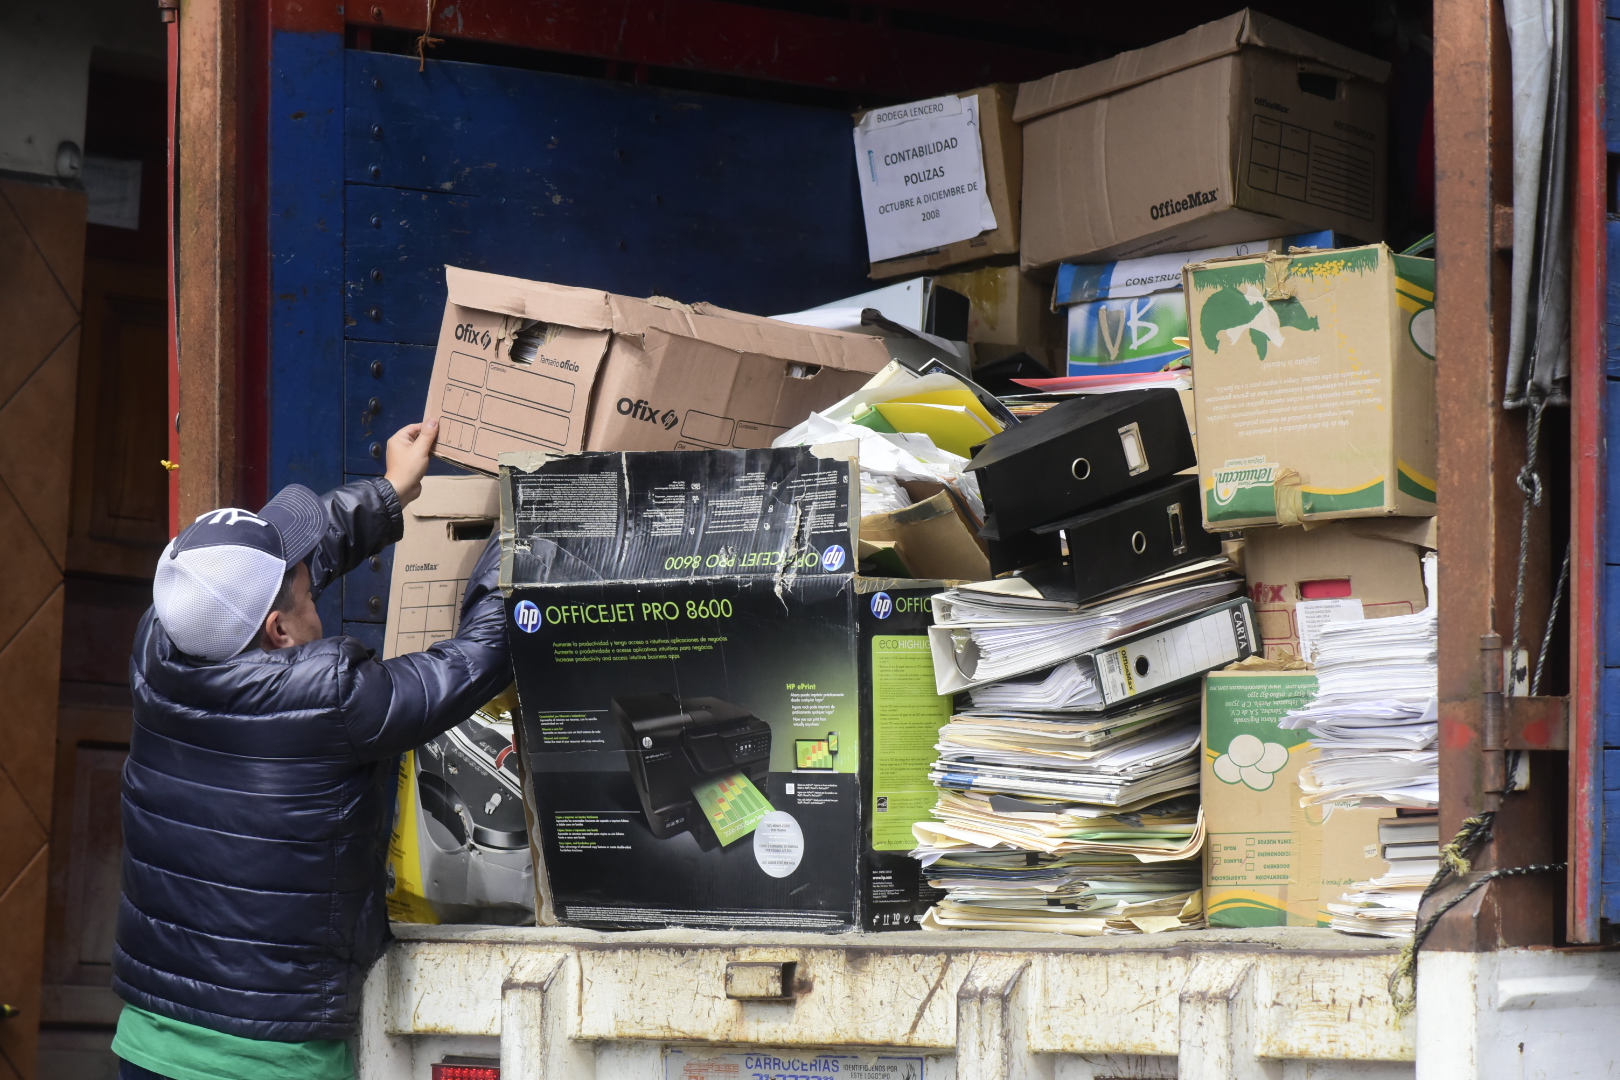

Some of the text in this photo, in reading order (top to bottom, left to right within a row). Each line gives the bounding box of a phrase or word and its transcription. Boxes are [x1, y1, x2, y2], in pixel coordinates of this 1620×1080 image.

[877, 103, 944, 123] BODEGA LENCERO
[1254, 97, 1290, 114] OfficeMax
[966, 108, 976, 126] 2
[884, 137, 958, 167] CONTABILIDAD
[904, 166, 945, 186] POLIZAS
[878, 181, 978, 215] OCTUBRE A DICIEMBRE DE
[1150, 187, 1219, 221] OfficeMax
[921, 209, 941, 222] 2008
[1125, 273, 1181, 287] CONSTRUC
[455, 323, 480, 346] Ofix
[540, 354, 580, 373] Tamaño oficio
[616, 397, 661, 424] Ofix
[1218, 467, 1274, 487] Tehuacán
[405, 563, 439, 572] OfficeMax
[665, 555, 702, 571] 8600
[824, 545, 844, 571] hp
[873, 592, 892, 619] hp
[519, 599, 733, 633] hp OFFICEJET PRO 8600
[1233, 611, 1248, 650] CARTA
[578, 639, 608, 647] productividad
[670, 635, 699, 644] aplicaciones
[574, 654, 600, 664] productivity
[1122, 650, 1135, 691] OfficeMax
[1233, 715, 1276, 724] Marca Registrada
[745, 1056, 840, 1073] CARROCERIAS
[886, 1065, 898, 1073] POR
[850, 1071, 864, 1079] ESTE
